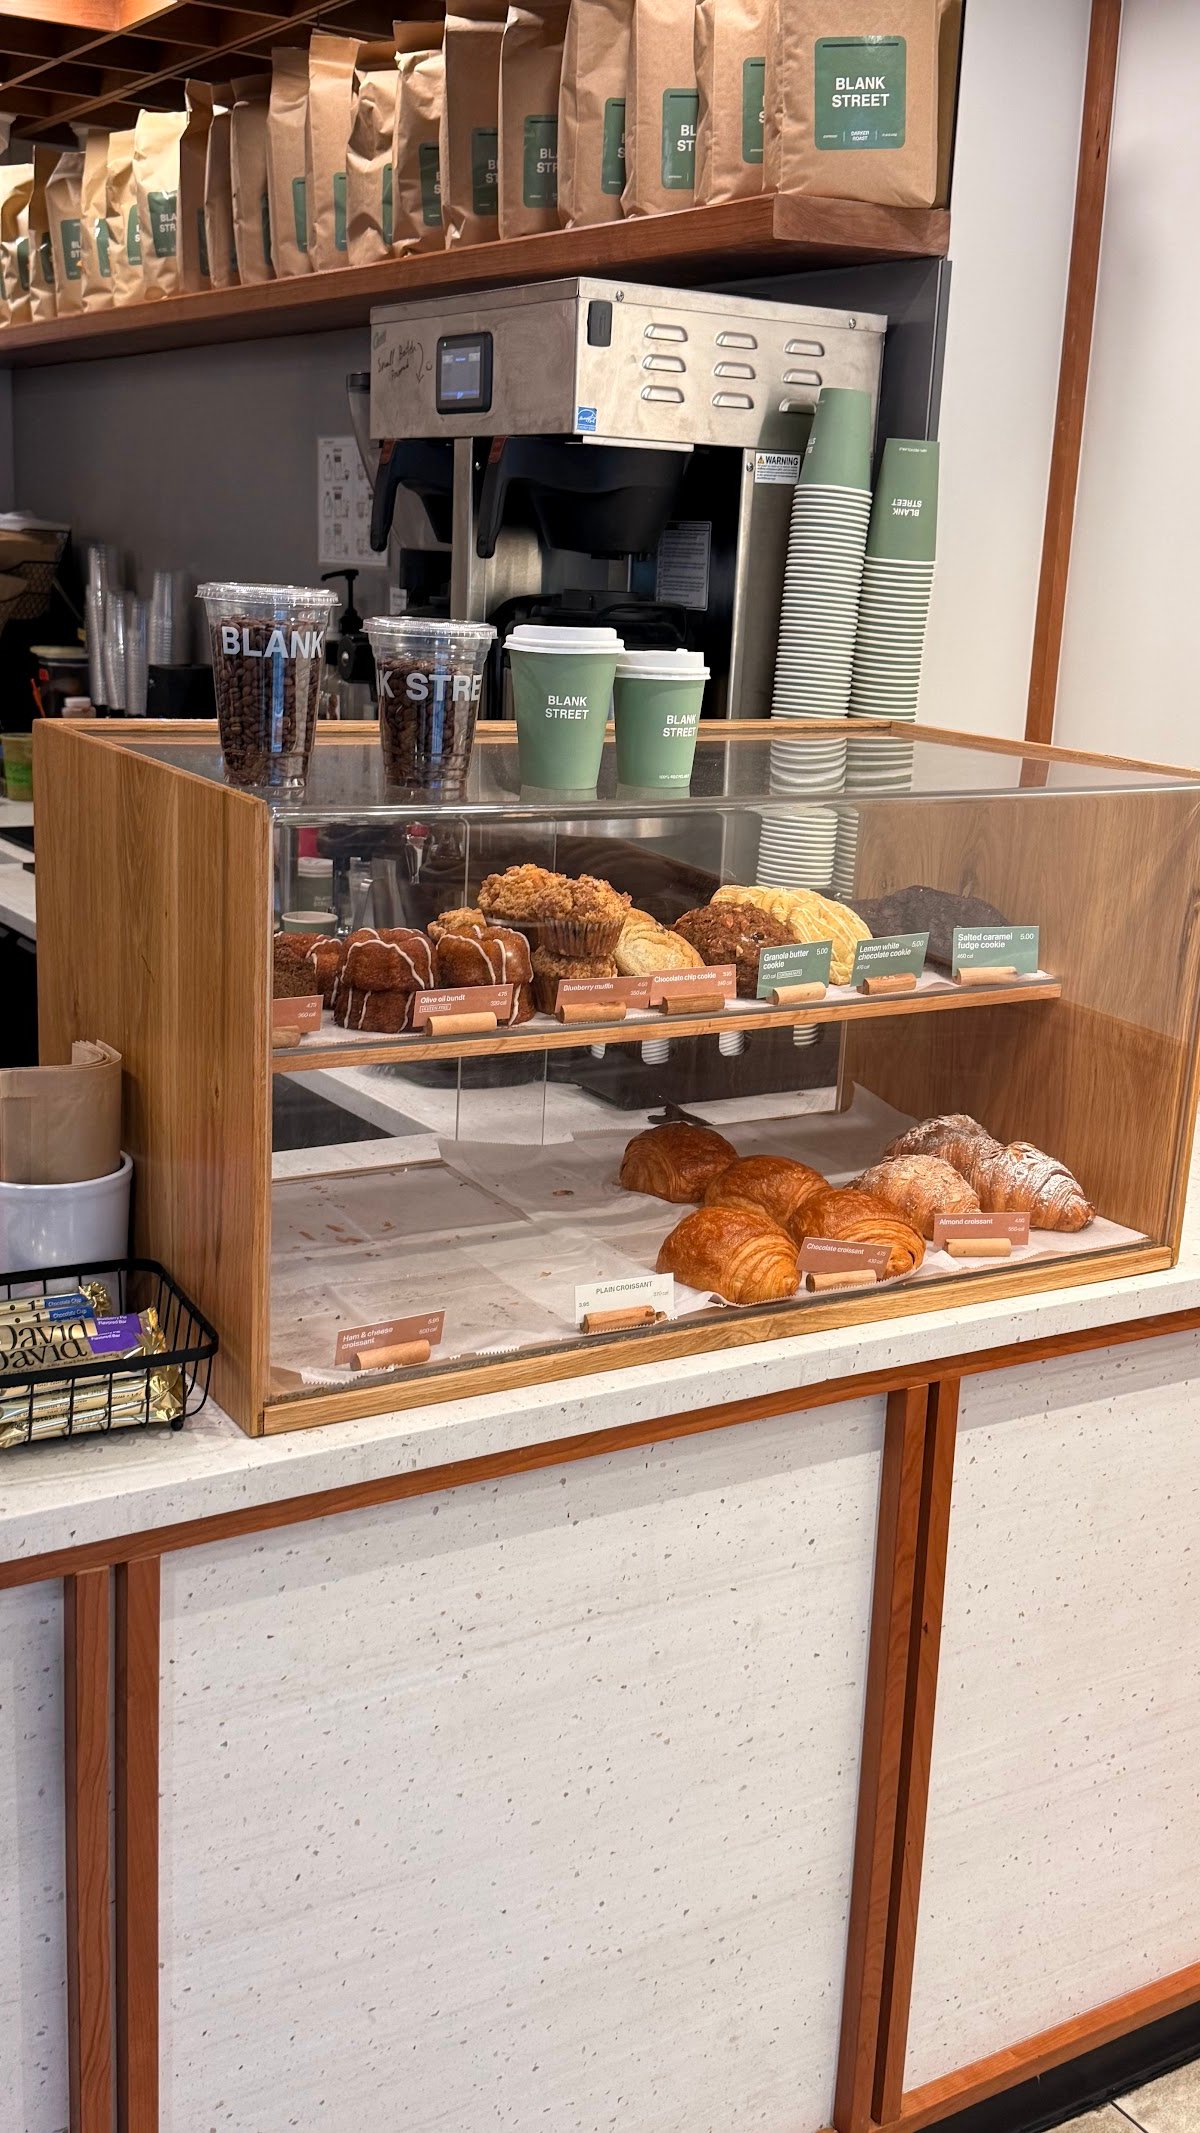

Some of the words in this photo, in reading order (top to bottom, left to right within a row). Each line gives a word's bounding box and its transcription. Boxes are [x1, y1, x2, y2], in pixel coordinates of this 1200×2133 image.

[835, 76, 886, 91] BLANK
[832, 94, 890, 108] STREET
[765, 455, 799, 466] WARNING
[890, 498, 922, 507] STREET
[892, 507, 919, 517] BLANK
[221, 624, 325, 659] BLANK
[548, 695, 588, 707] BLANK
[545, 708, 590, 720] STREET
[666, 714, 697, 725] BLANK
[662, 727, 697, 737] STREET
[958, 933, 982, 941] Salted
[983, 932, 1013, 941] caramel
[860, 944, 882, 953] Lemon
[882, 942, 899, 951] white
[912, 940, 924, 948] 5.00
[958, 942, 980, 950] fudge
[981, 941, 1005, 949] cookie
[764, 952, 789, 962] Granola
[790, 949, 810, 958] butter
[816, 947, 828, 956] 5.00
[858, 951, 890, 961] chocolate
[890, 948, 911, 957] cookie
[763, 960, 785, 970] cookie
[654, 975, 684, 983] Chocolate
[684, 973, 697, 982] chip
[697, 972, 717, 980] cookie
[564, 984, 594, 993] Blueberry
[594, 982, 614, 990] muffin
[420, 996, 437, 1004] Olive
[438, 994, 446, 1002] oil
[446, 994, 466, 1002] bundt
[806, 1242, 837, 1252] Chocolate
[838, 1246, 864, 1255] croissant
[596, 1286, 615, 1295] PLAIN
[616, 1280, 653, 1292] CROISSANT
[343, 1333, 360, 1343] Ham
[367, 1326, 394, 1337] cheese
[342, 1337, 375, 1350] croissant
[0, 1338, 88, 1370] avid
